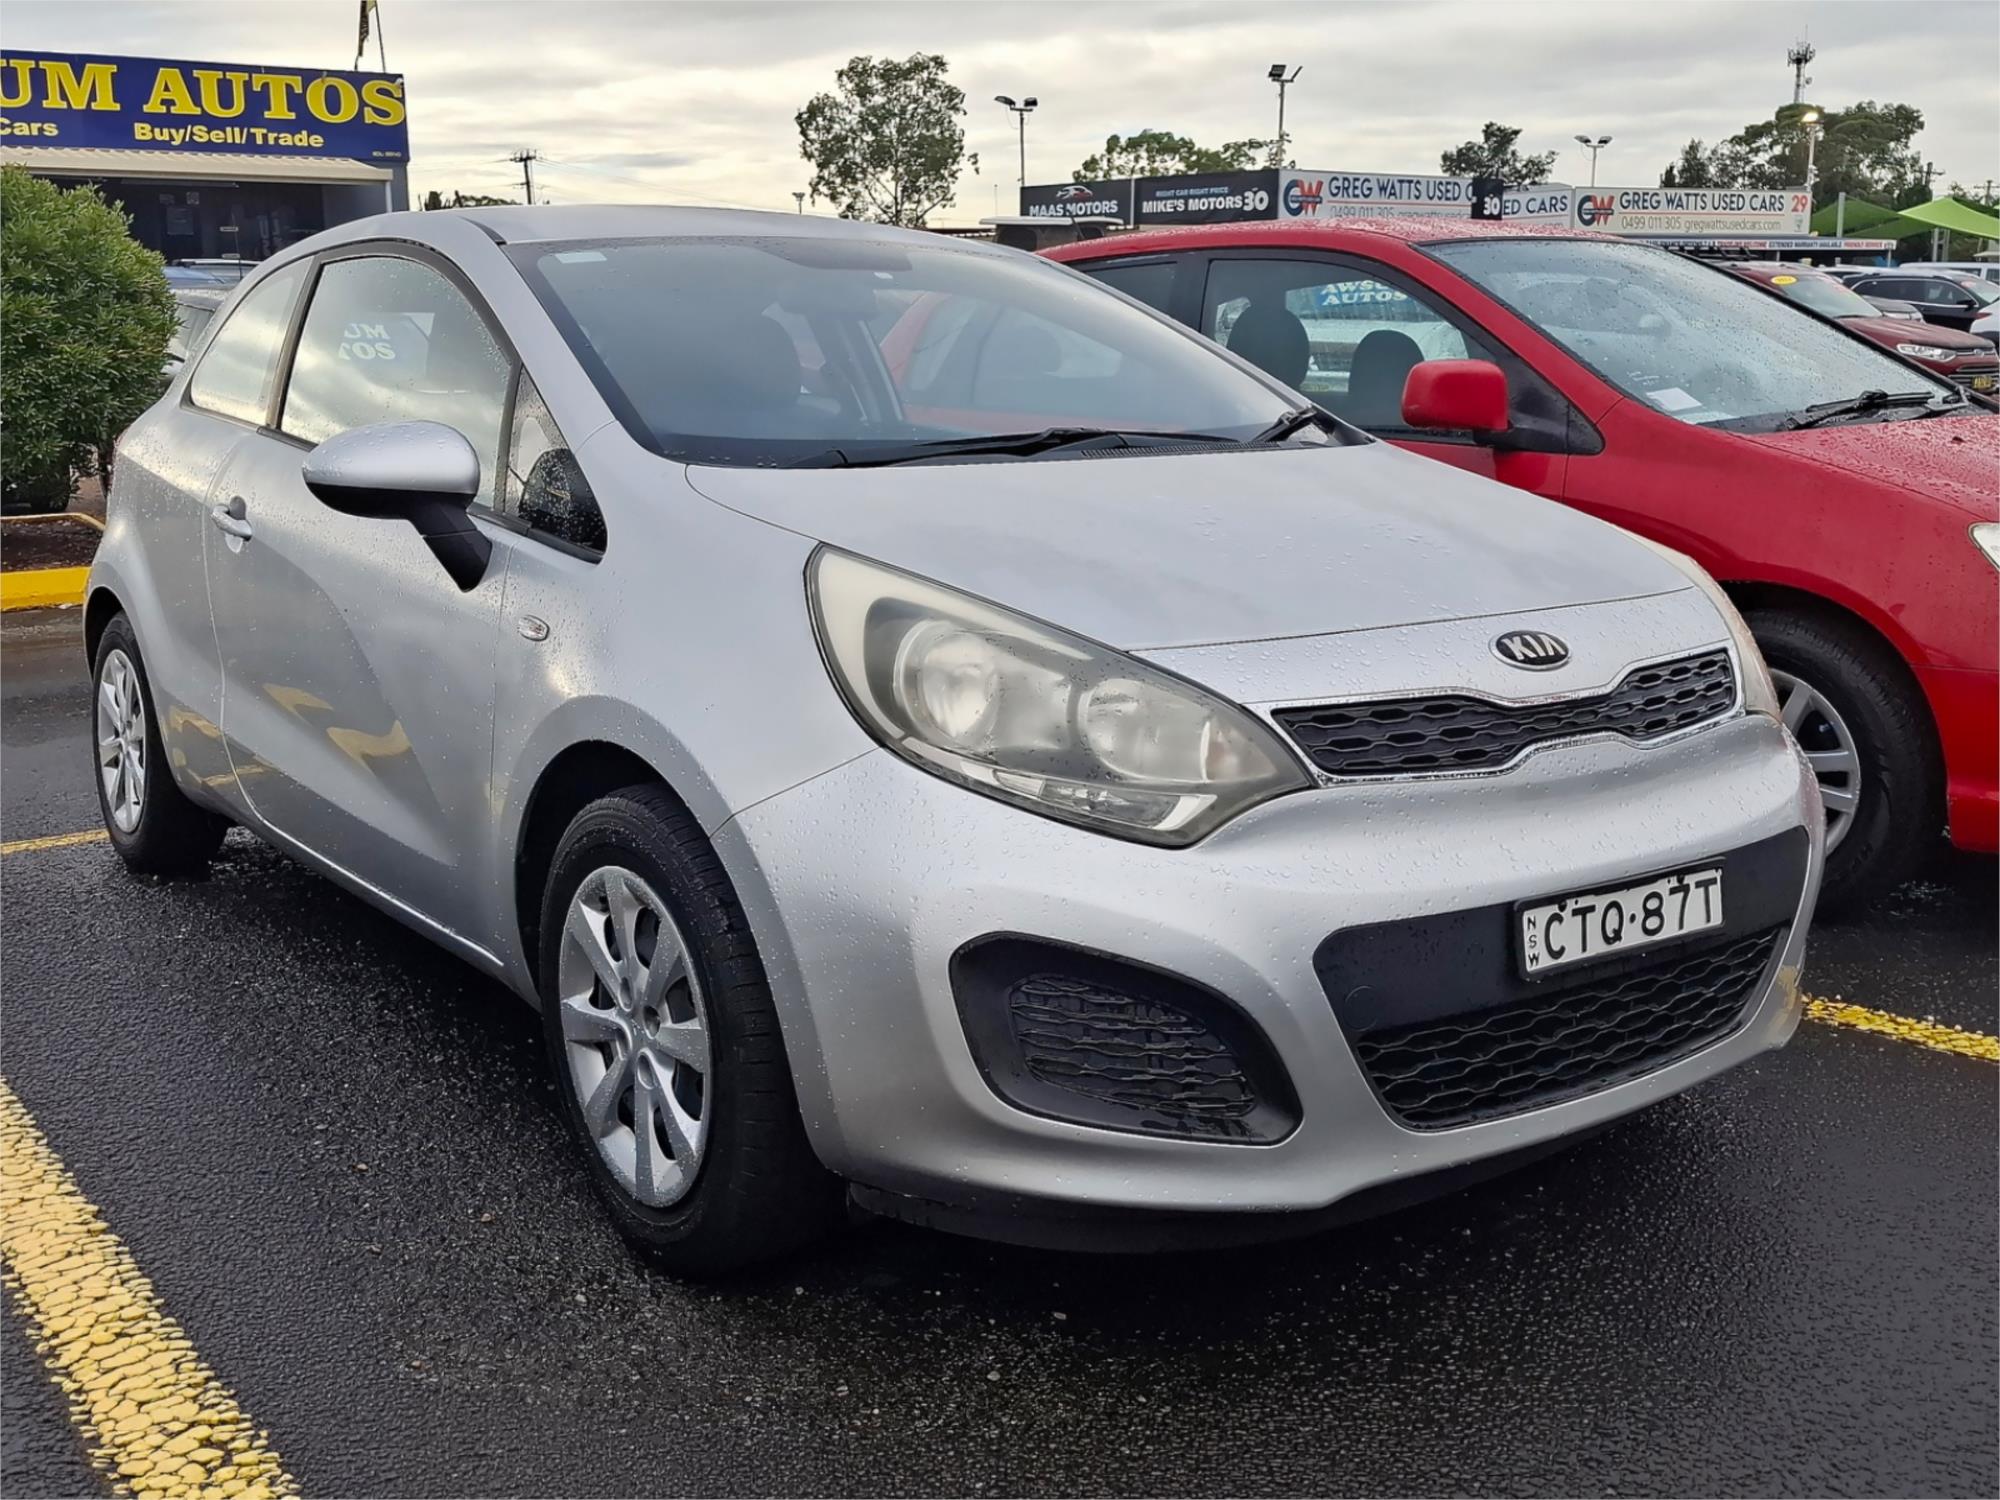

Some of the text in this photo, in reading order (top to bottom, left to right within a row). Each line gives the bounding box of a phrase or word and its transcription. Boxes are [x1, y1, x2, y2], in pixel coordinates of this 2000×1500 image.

[143, 67, 406, 126] AUTOS
[0, 117, 59, 137] Cars
[1328, 176, 1372, 198] GREG
[1376, 178, 1422, 200] WATTS
[1426, 181, 1463, 201] USED
[1029, 200, 1119, 217] MAAS MOTORS
[1142, 196, 1243, 213] MIKE'S MOTORS
[1243, 190, 1269, 211] 30
[1483, 196, 1500, 215] 30
[1526, 195, 1568, 214] CARS
[1619, 191, 1785, 212] GREG WATTS USED CARS
[1791, 195, 1808, 213] 29
[1621, 215, 1782, 233] 0499 011 305 gregwattsusedcars.com
[1500, 633, 1567, 661] KIA
